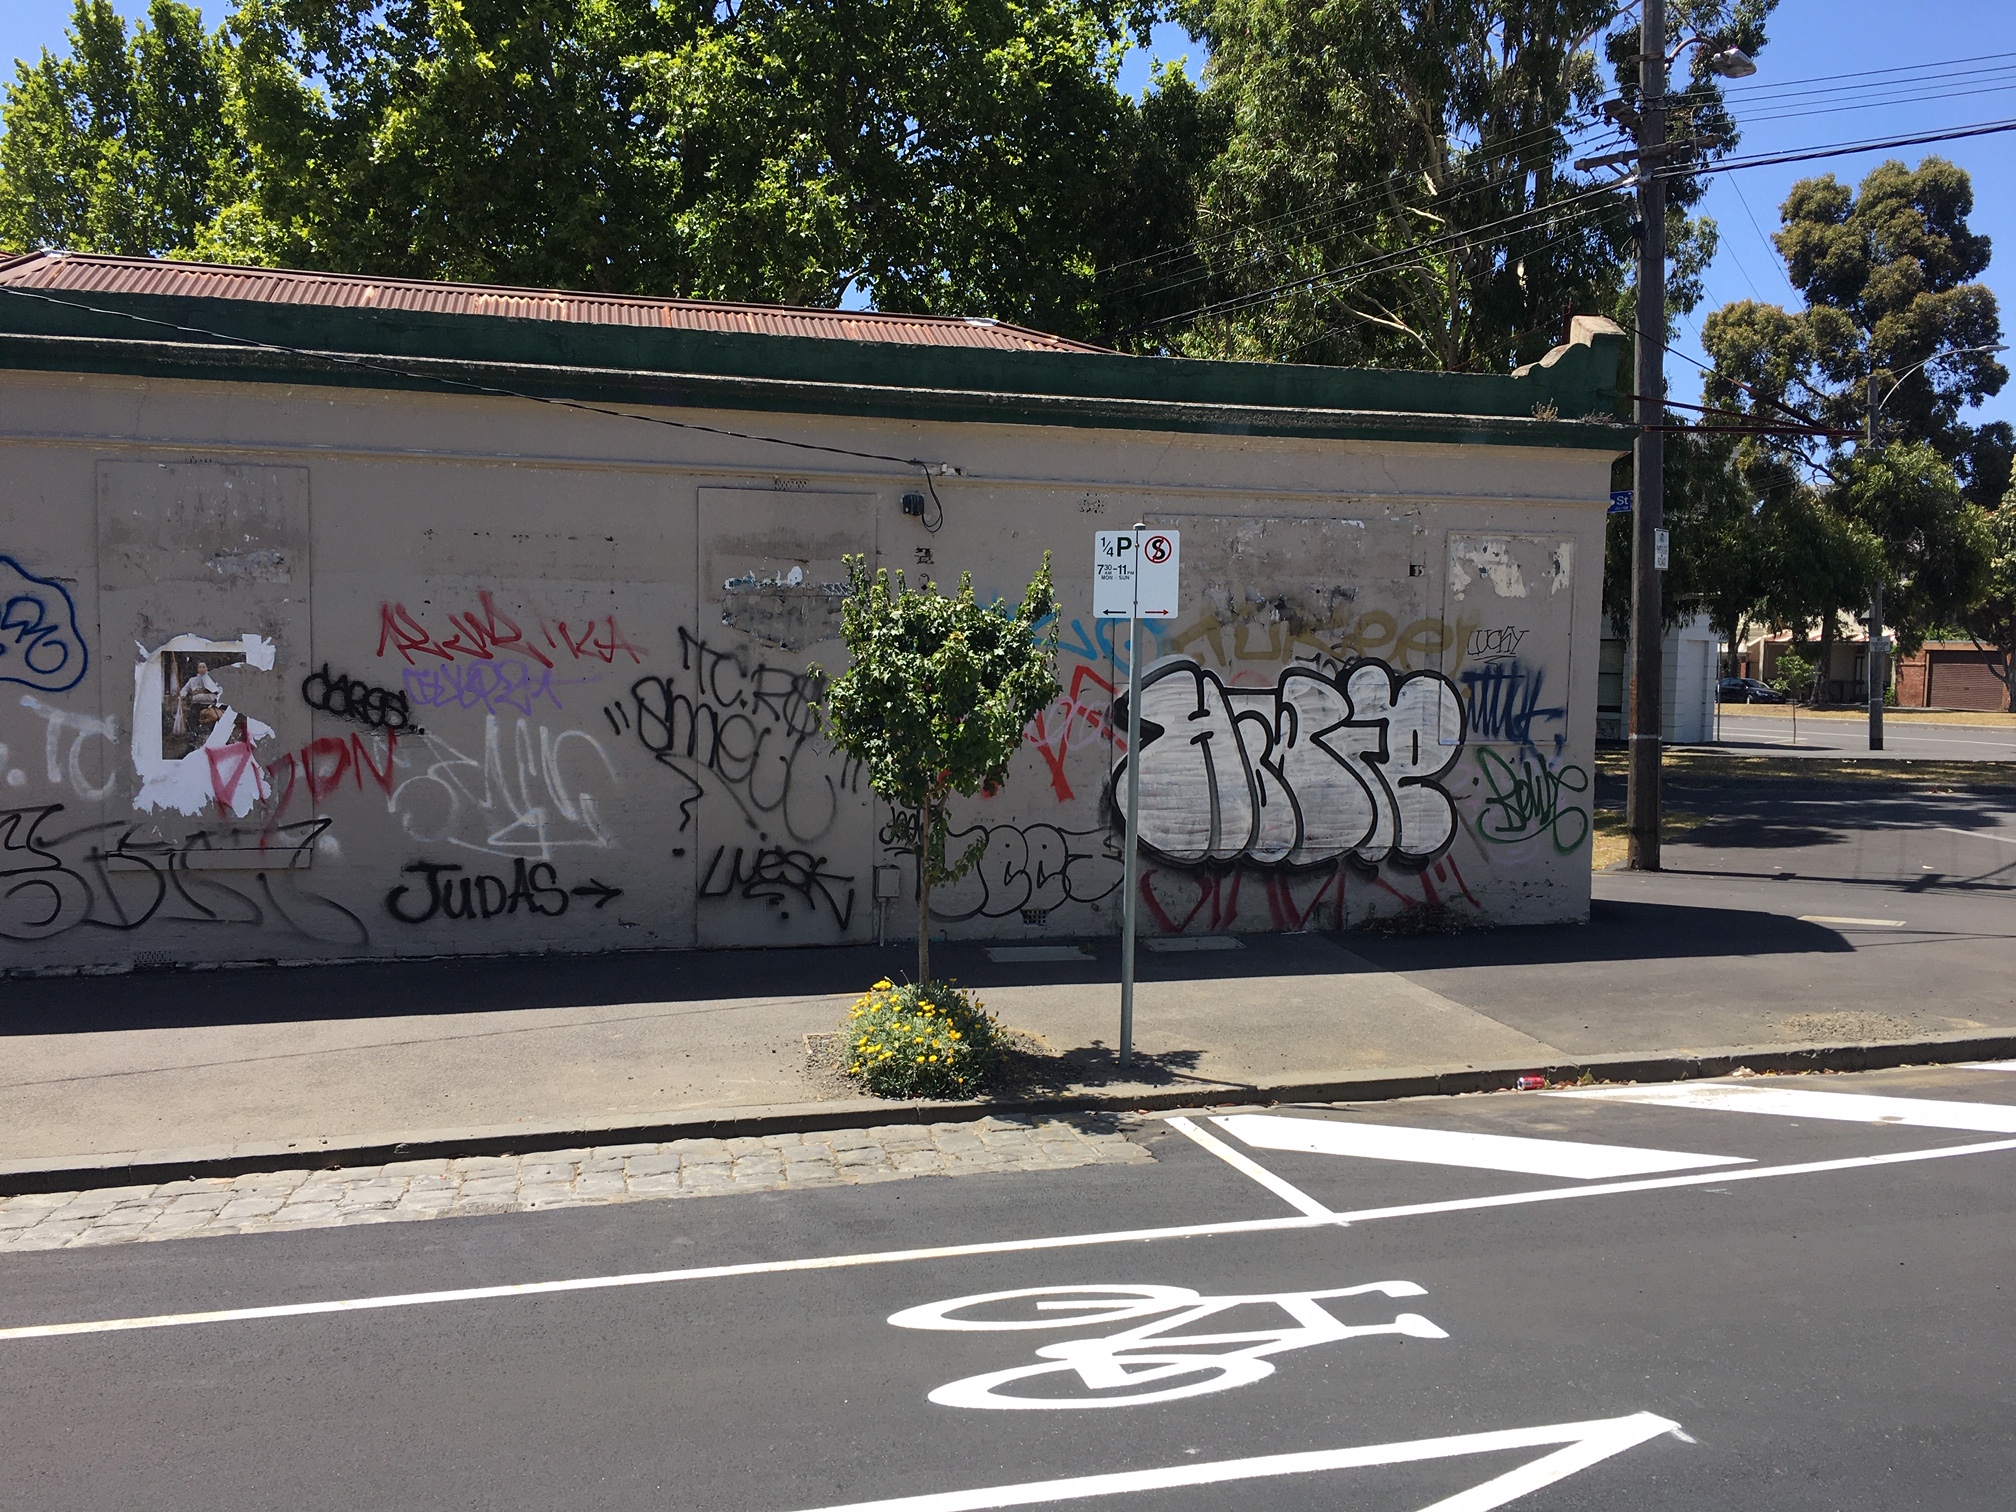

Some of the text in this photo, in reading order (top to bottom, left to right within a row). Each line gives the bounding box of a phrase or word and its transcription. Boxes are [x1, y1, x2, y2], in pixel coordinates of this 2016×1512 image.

[1616, 495, 1629, 506] St
[1116, 536, 1132, 557] P
[384, 858, 569, 924] JUDAS
